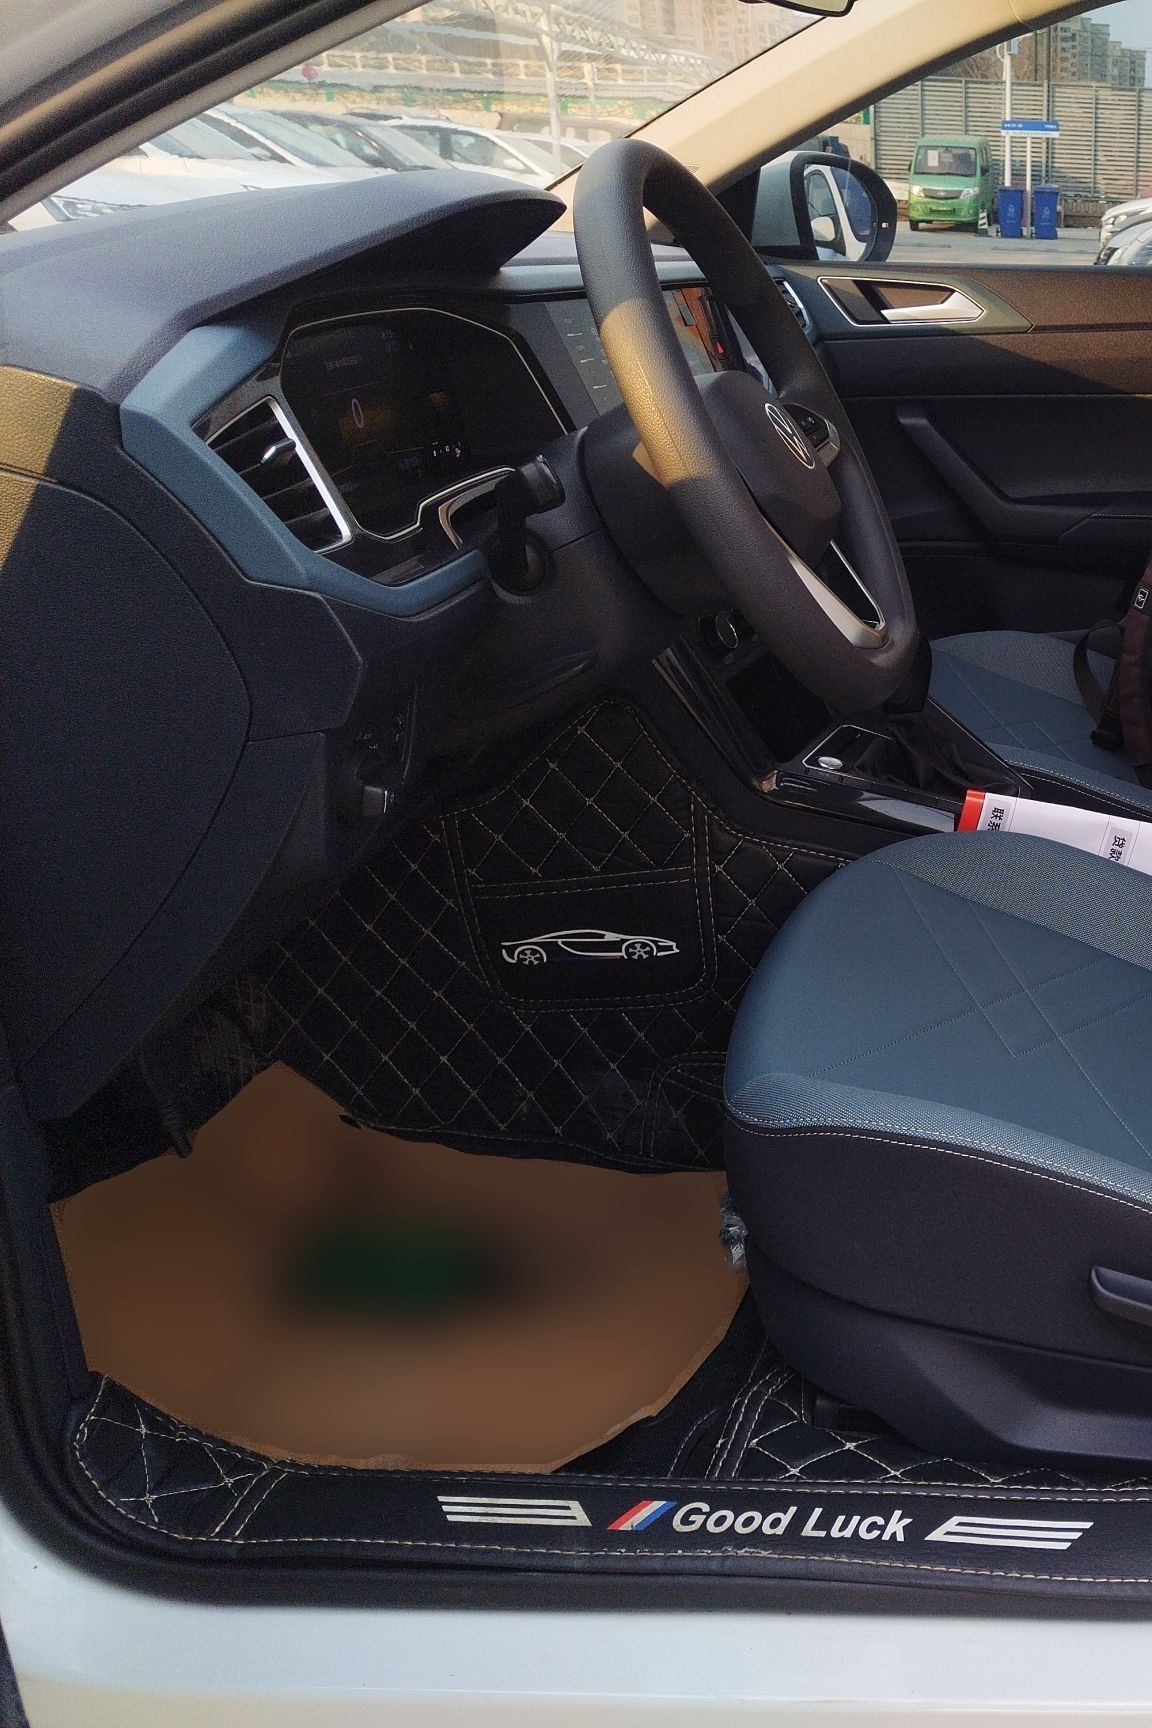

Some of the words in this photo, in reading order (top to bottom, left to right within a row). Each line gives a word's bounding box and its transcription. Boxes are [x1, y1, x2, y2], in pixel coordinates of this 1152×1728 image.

[1108, 835, 1126, 861] 贷款
[672, 1501, 797, 1535] Good
[800, 1507, 914, 1542] Luck
